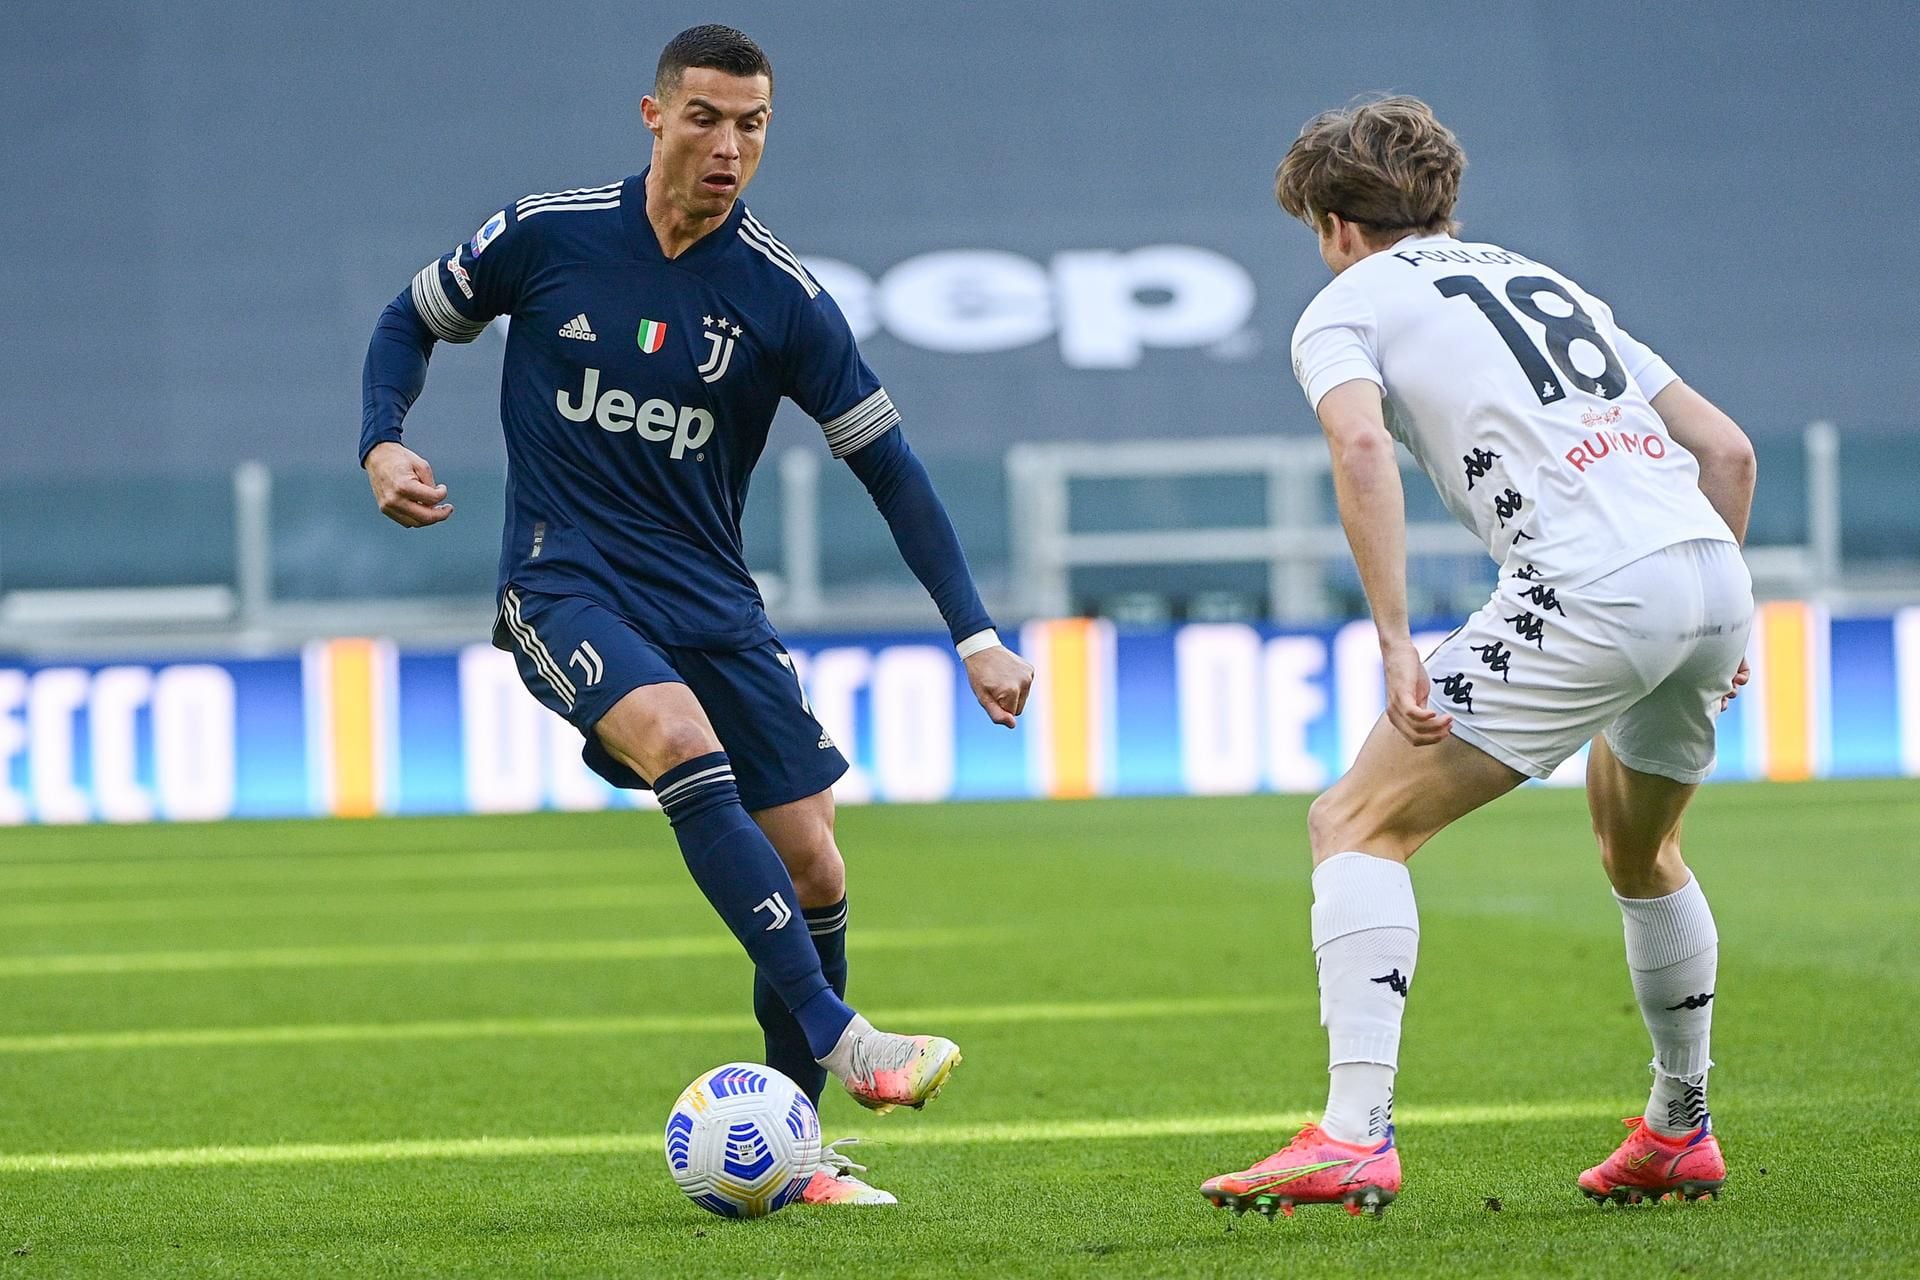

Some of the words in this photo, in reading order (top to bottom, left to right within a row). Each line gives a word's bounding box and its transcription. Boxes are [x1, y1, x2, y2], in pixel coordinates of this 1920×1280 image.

[558, 328, 597, 342] adidas
[1433, 275, 1627, 406] 18
[556, 367, 715, 460] Jeep
